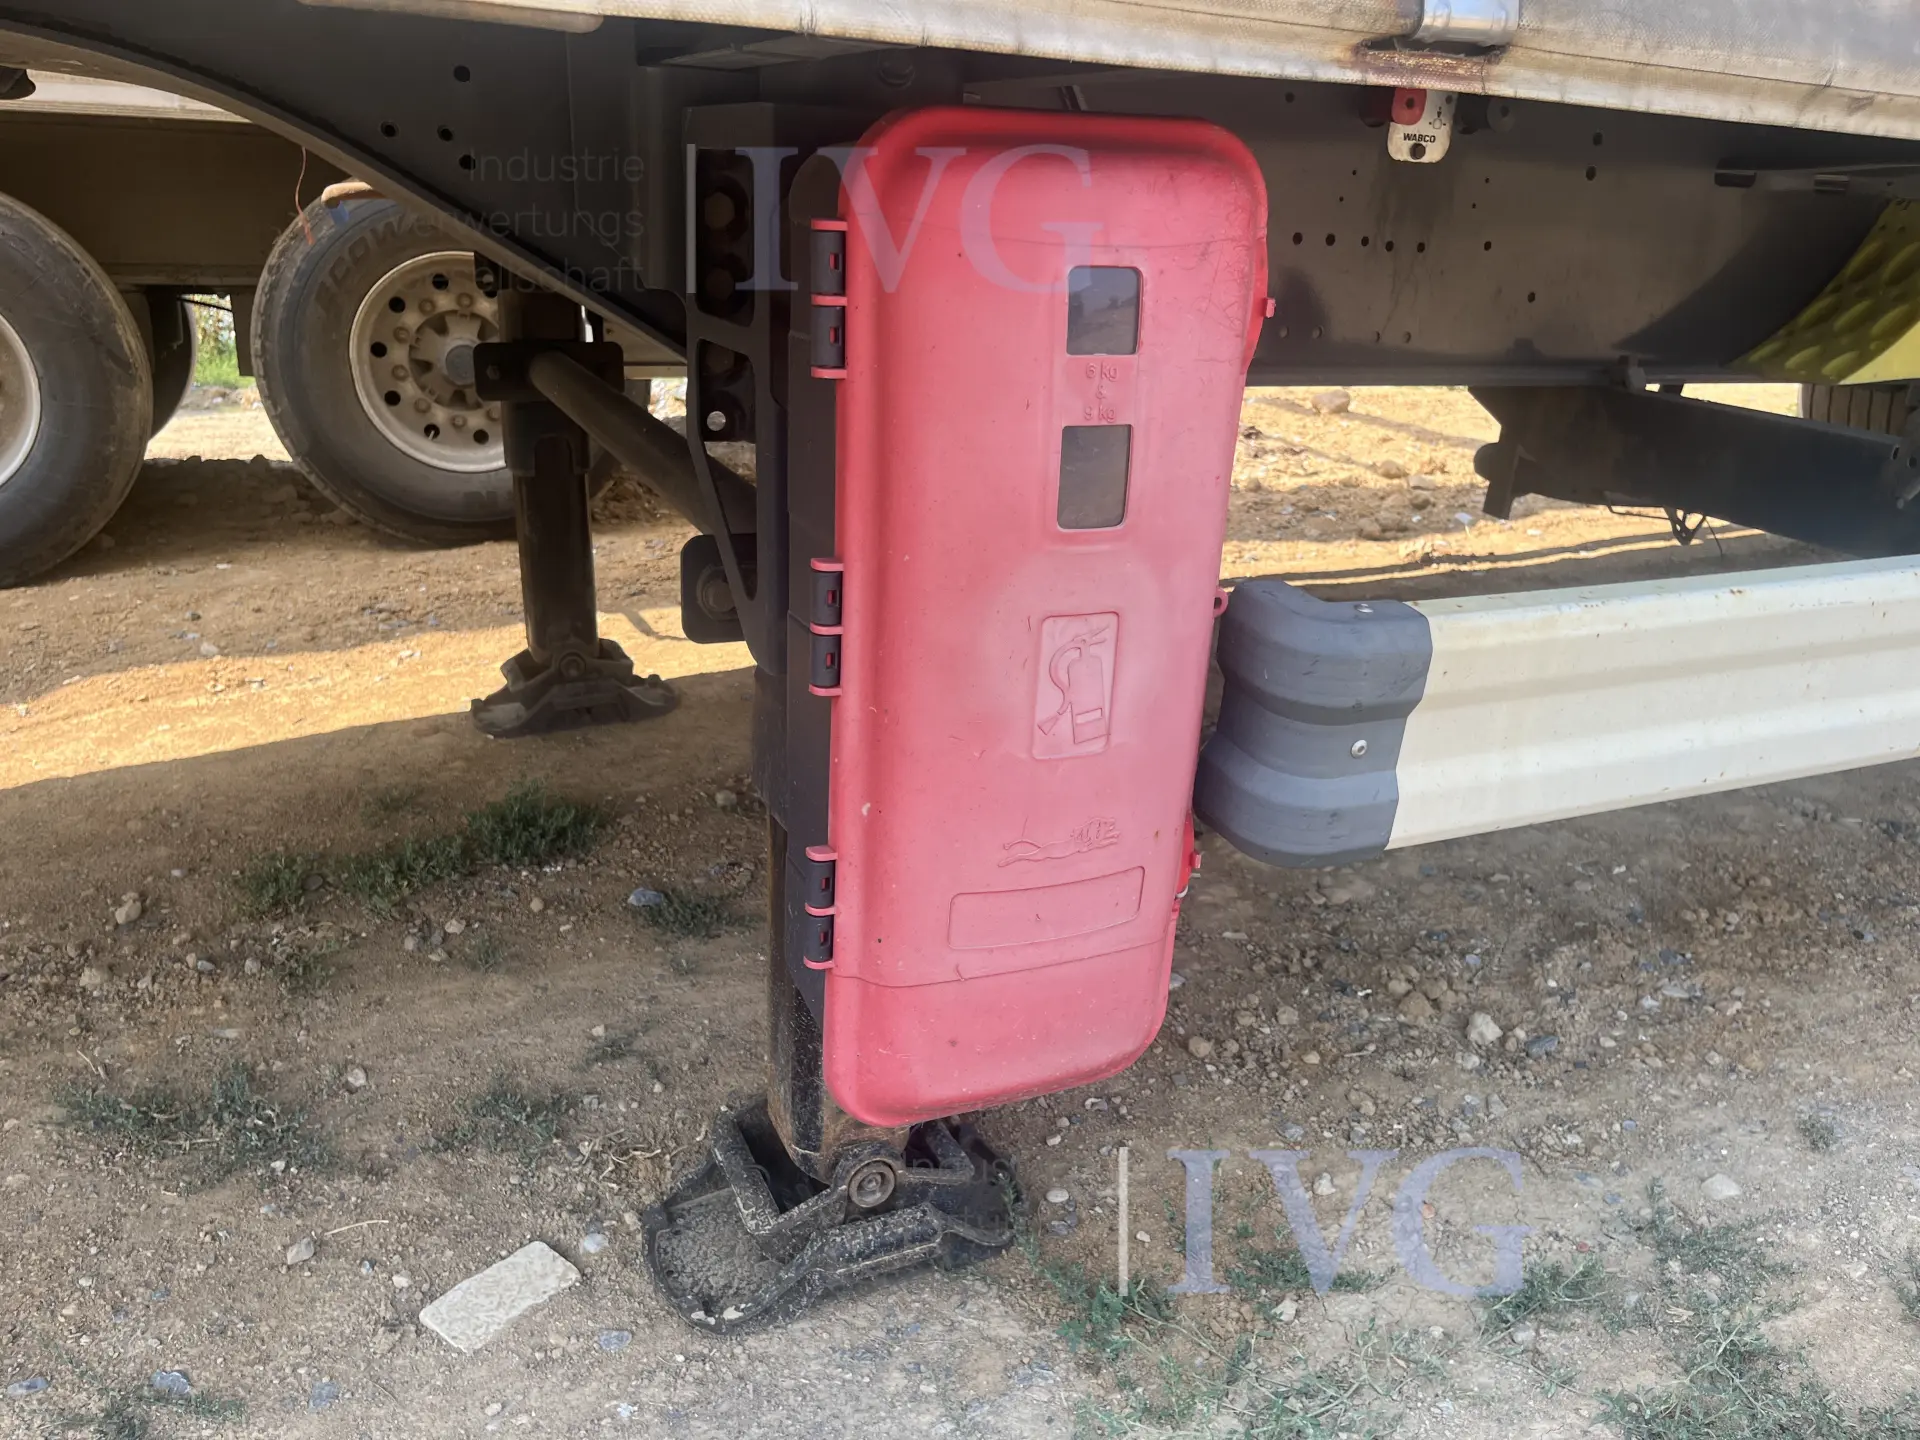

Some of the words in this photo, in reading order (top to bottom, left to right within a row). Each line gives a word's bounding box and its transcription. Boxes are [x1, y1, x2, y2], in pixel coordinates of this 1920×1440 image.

[1403, 132, 1437, 143] WABCO
[1086, 362, 1097, 379] 6
[1101, 360, 1119, 382] kg
[1084, 405, 1095, 421] 9
[1098, 403, 1117, 423] kg
